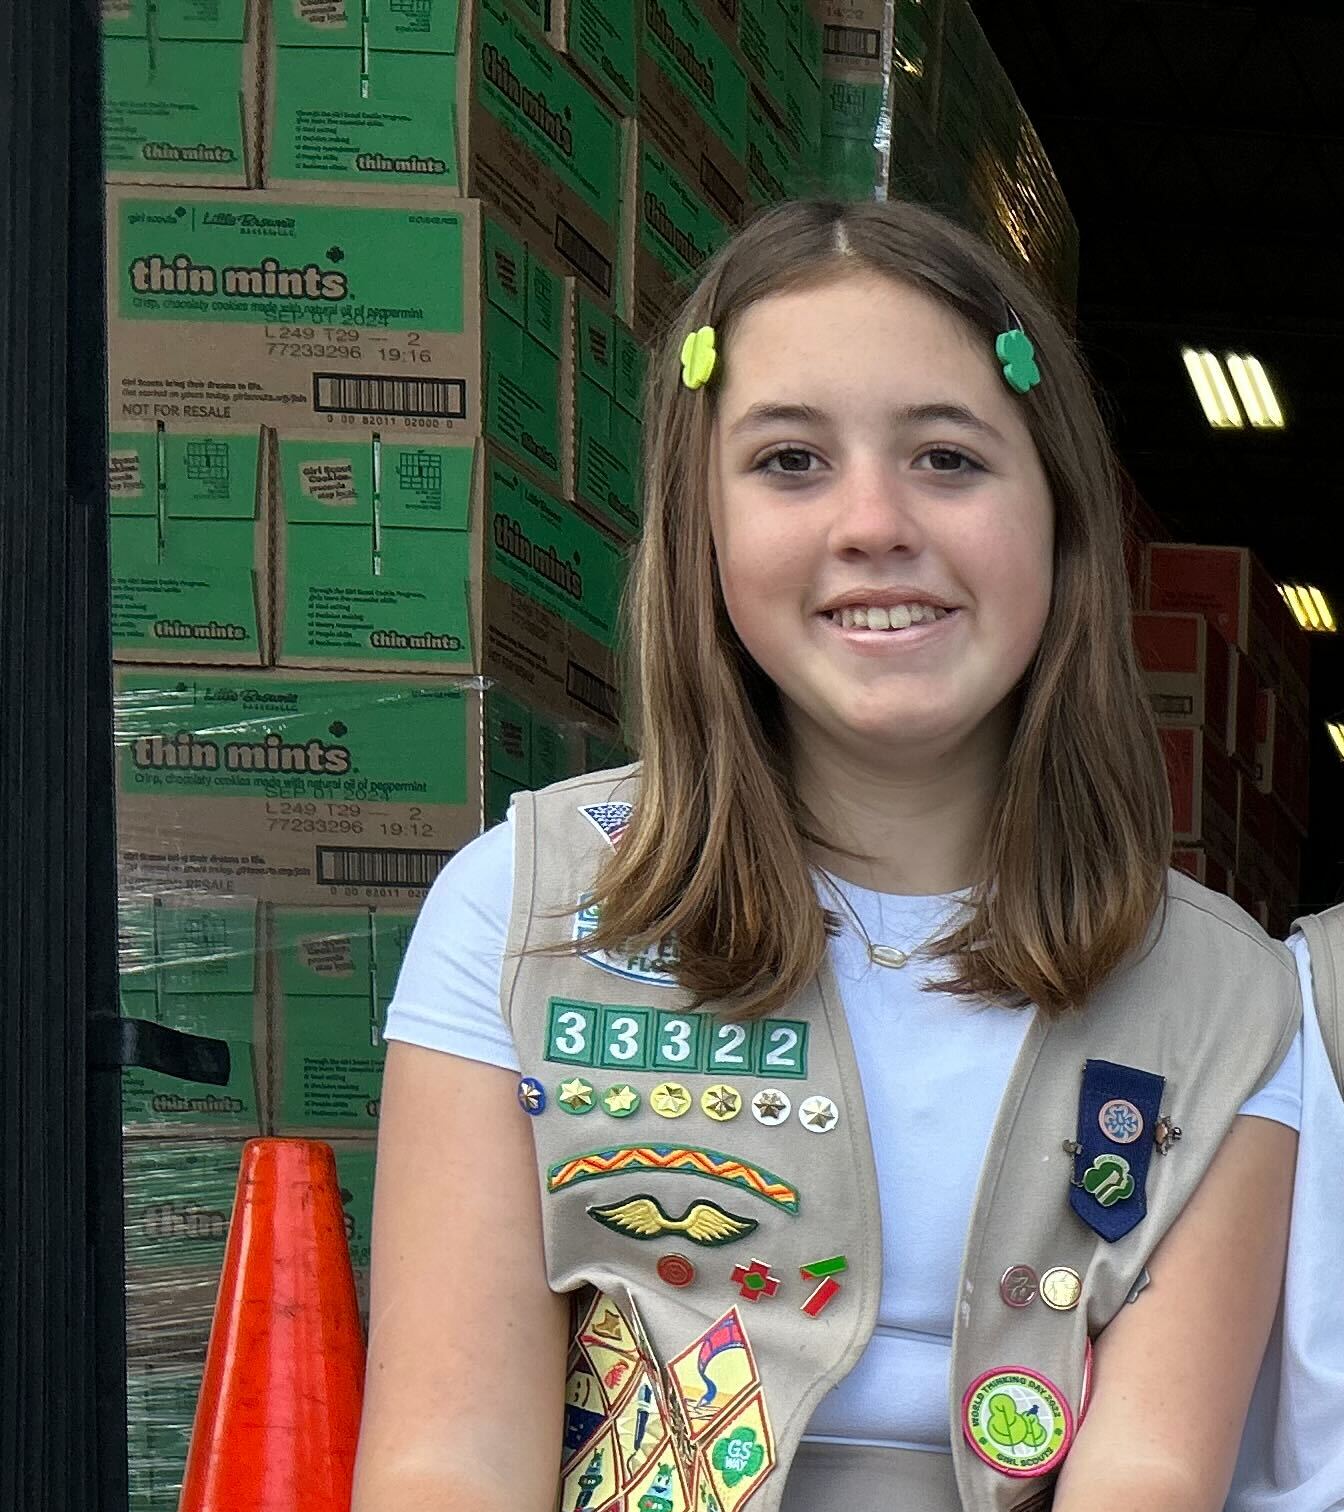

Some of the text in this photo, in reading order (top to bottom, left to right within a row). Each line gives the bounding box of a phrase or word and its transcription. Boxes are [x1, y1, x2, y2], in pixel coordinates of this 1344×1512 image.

[143, 144, 232, 161] thin mints
[357, 155, 446, 174] thin mints
[130, 254, 348, 299] thin mints
[324, 328, 359, 341] T29
[408, 332, 420, 346] 2
[266, 343, 431, 363] 77233296 19:16
[122, 404, 231, 418] NOT FOR RESALE
[154, 620, 246, 640] thin mints
[370, 630, 460, 650] thin mints
[133, 733, 349, 774] thin mints
[328, 804, 361, 817] T29
[409, 808, 422, 821] 2
[266, 818, 434, 837] 77233296 19:12
[554, 1010, 799, 1066] 33322
[972, 1391, 984, 1427] WORLD
[983, 1376, 1026, 1393] THINKING
[1028, 1380, 1047, 1394] DAY
[727, 1439, 752, 1458] GS
[1020, 1447, 1054, 1466] SCOUTS
[724, 1455, 748, 1471] WAY
